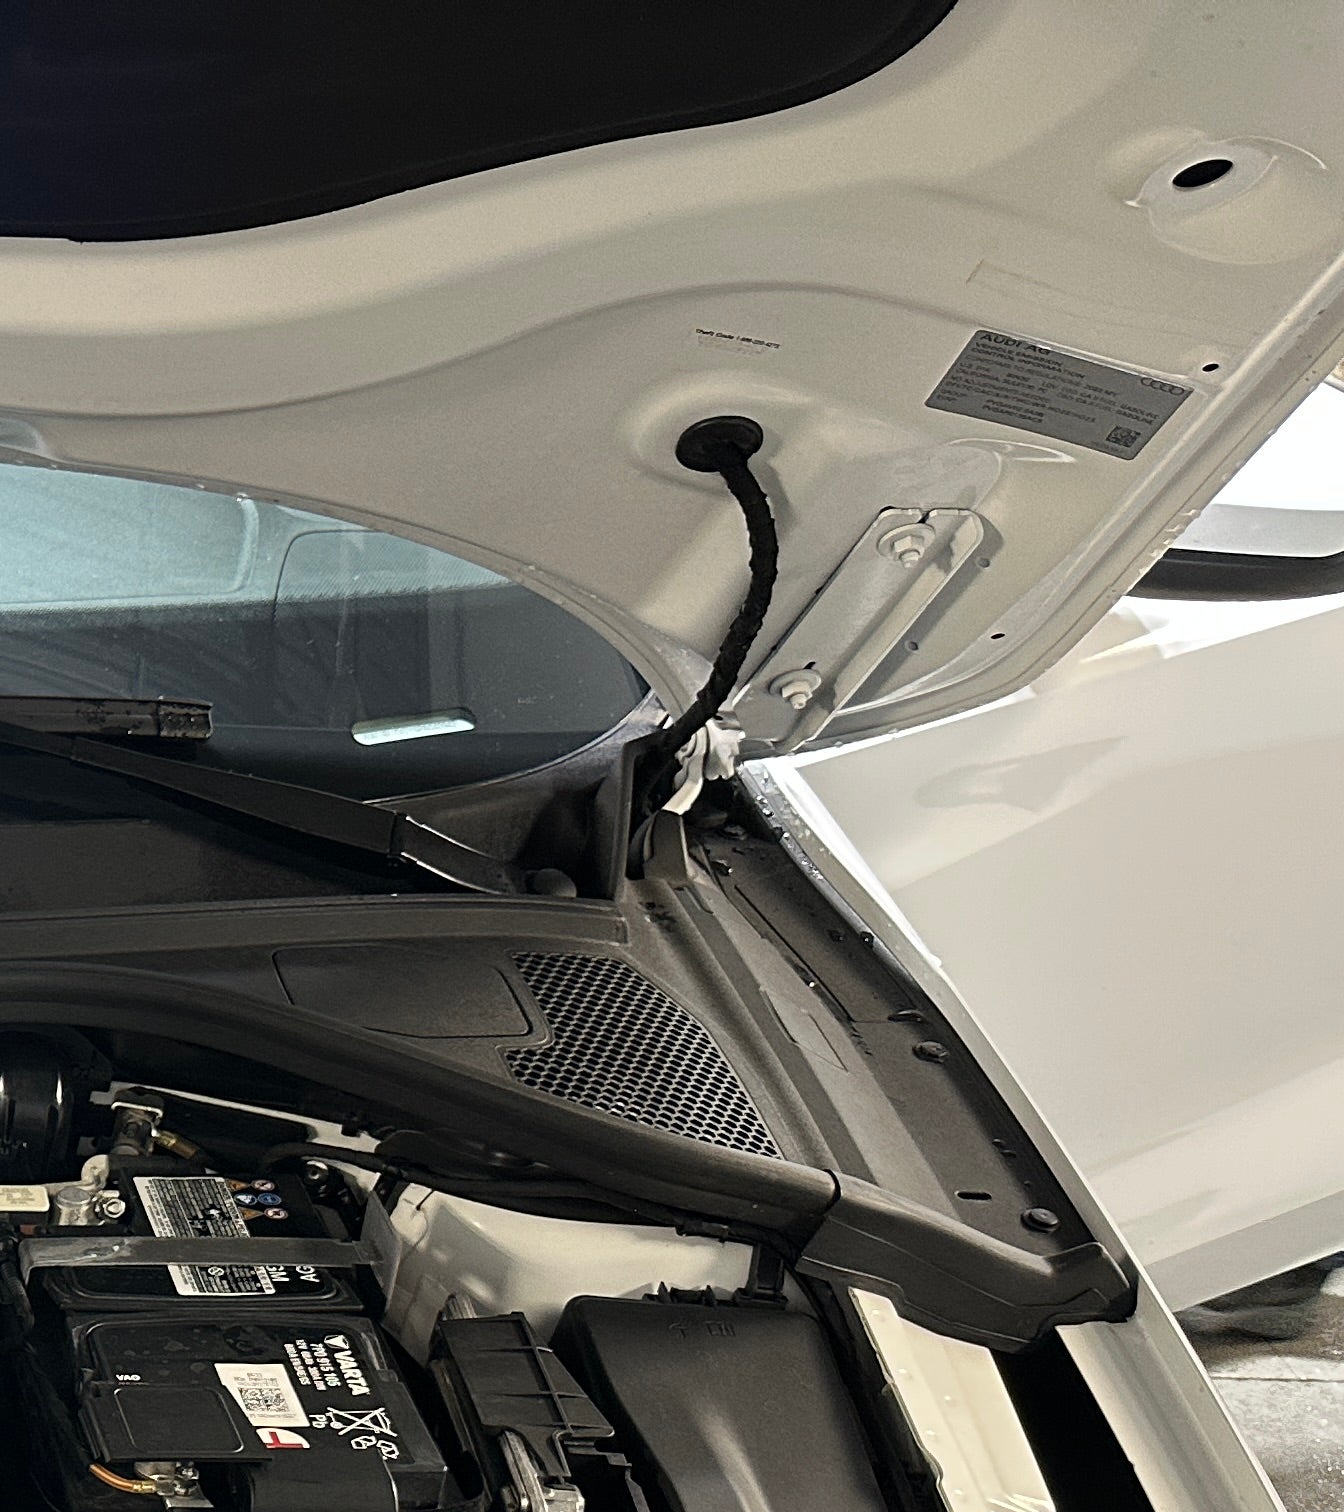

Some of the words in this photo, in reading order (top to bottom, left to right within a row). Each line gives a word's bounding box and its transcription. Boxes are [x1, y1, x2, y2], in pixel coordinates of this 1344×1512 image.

[980, 334, 1022, 347] AUDI
[1025, 344, 1050, 355] AG
[334, 1350, 371, 1396] VARTA
[309, 1414, 329, 1429] Pb
